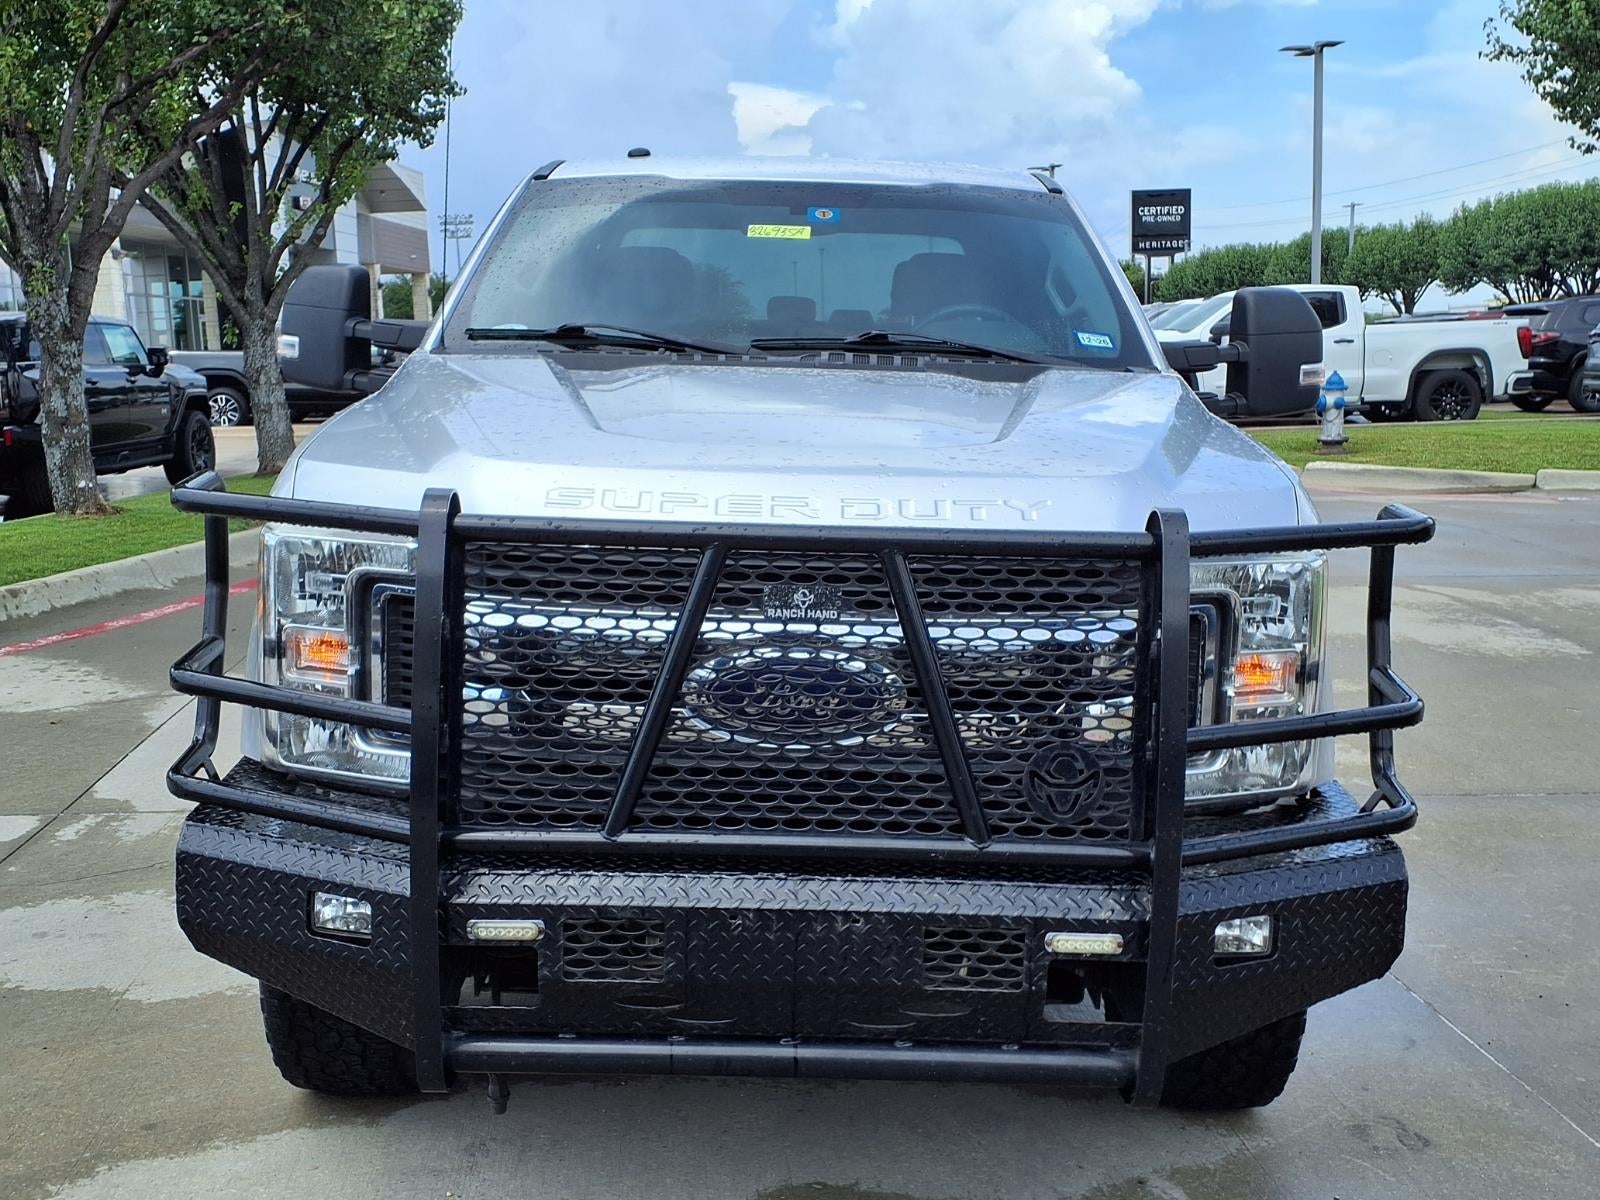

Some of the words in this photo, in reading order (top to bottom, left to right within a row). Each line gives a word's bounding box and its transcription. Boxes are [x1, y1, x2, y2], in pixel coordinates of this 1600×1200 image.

[1138, 205, 1185, 216] CERTIFIED
[1138, 240, 1184, 249] HERITAGE
[544, 486, 820, 518] SUPER
[840, 497, 1051, 521] DUTY
[767, 608, 805, 619] RANCH
[807, 609, 838, 619] HAND
